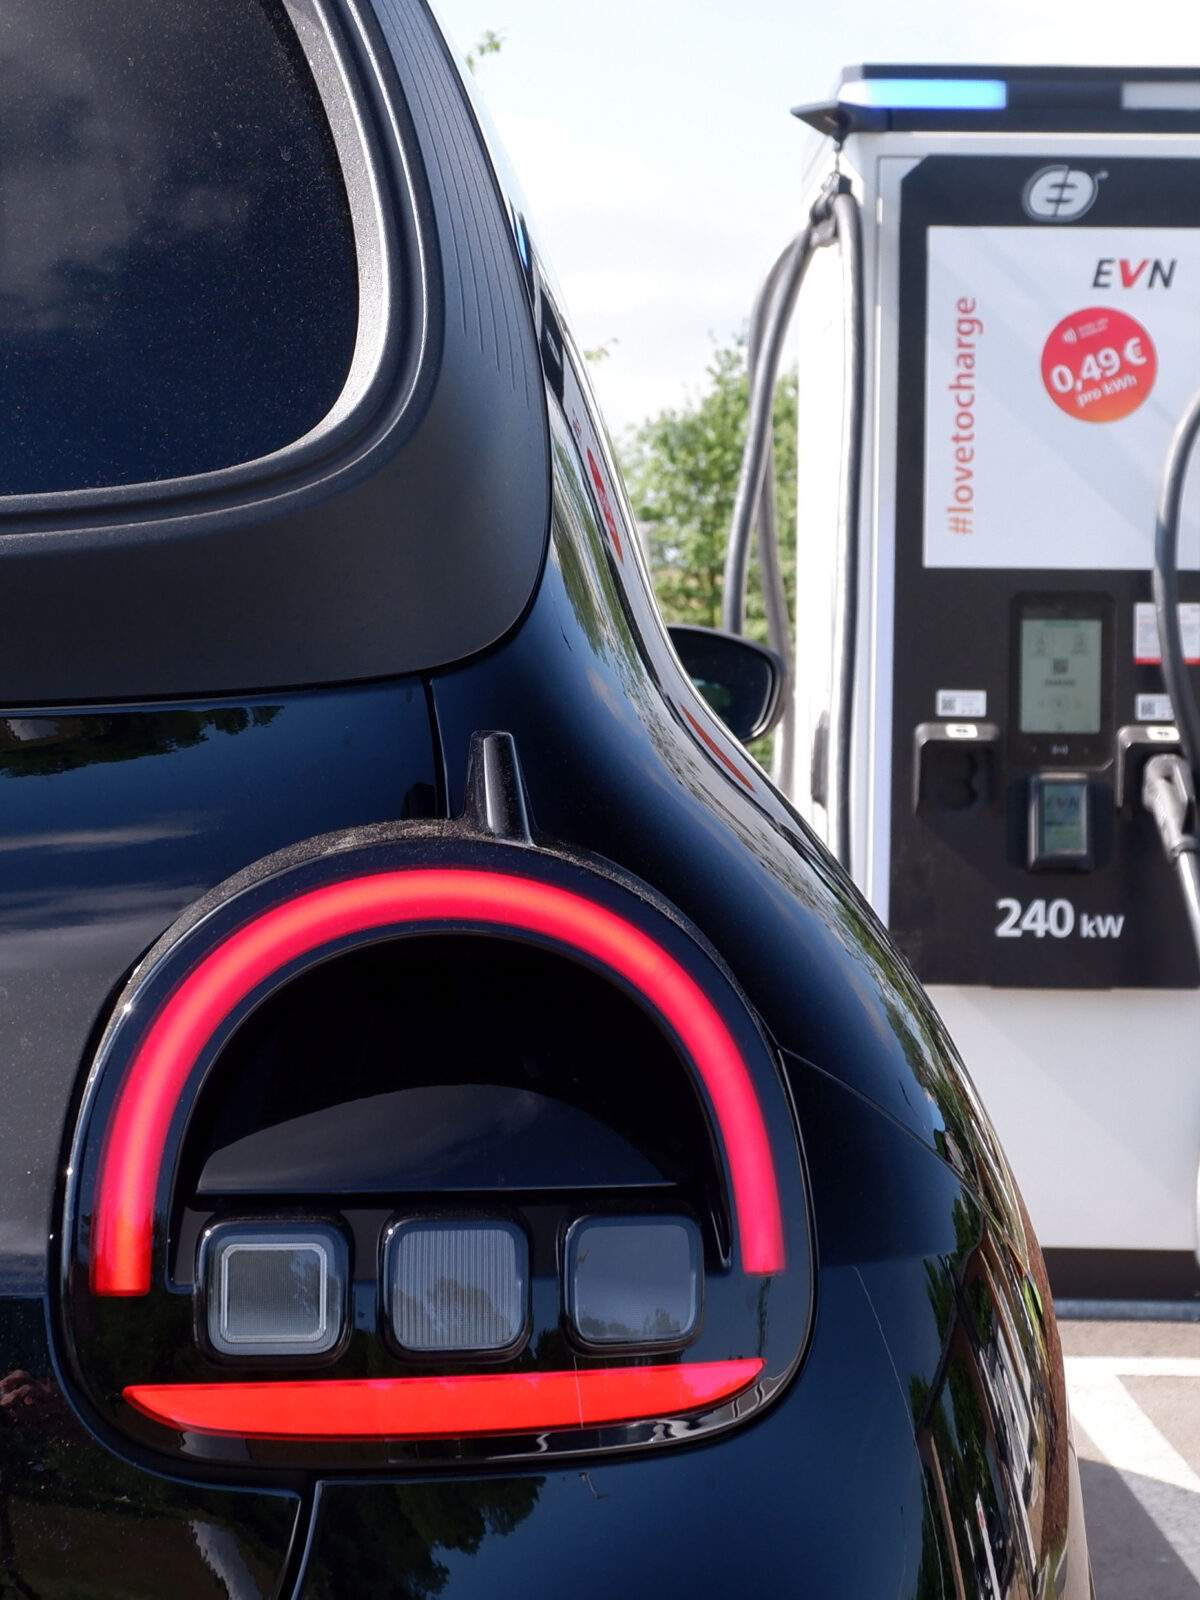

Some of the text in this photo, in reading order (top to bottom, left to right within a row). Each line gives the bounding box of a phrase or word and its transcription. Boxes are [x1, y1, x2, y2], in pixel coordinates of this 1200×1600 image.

[1091, 258, 1177, 289] EVN
[1051, 336, 1148, 394] 0,49 €
[1076, 374, 1137, 408] pro kWh
[947, 297, 984, 535] #lovetocharge
[996, 898, 1125, 938] 240 kW
